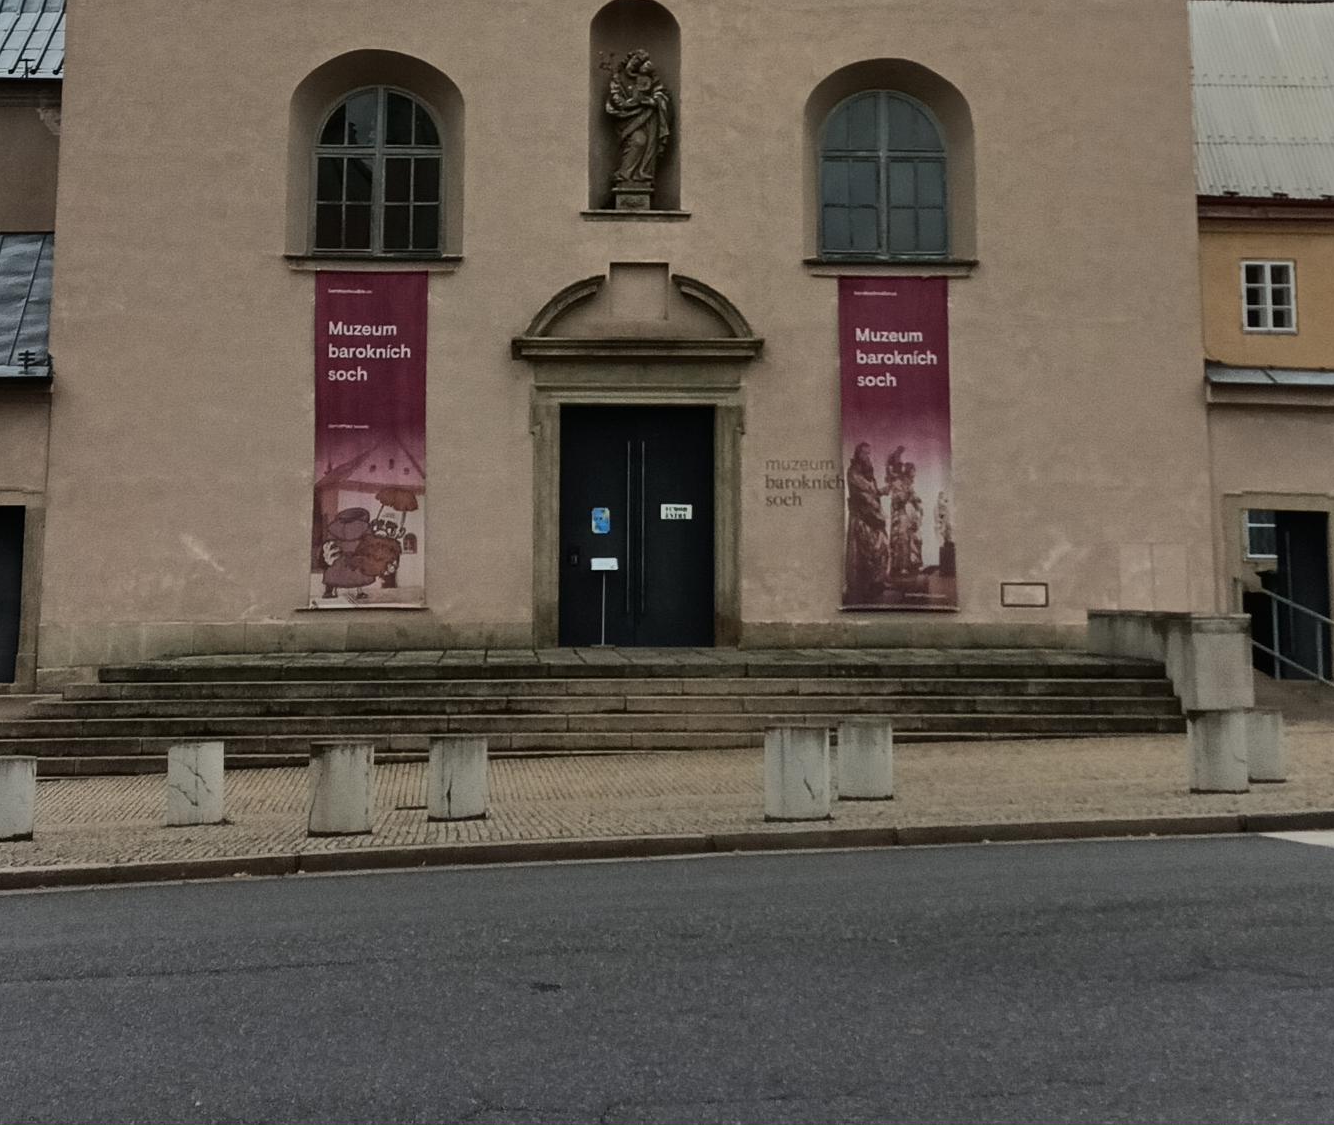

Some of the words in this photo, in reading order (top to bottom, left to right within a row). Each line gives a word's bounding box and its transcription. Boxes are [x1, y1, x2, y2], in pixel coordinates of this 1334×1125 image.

[328, 321, 397, 336] Muzeum
[855, 327, 923, 343] Muzeum
[328, 343, 411, 359] barokních
[856, 349, 938, 365] barokních
[327, 365, 368, 382] soch
[856, 372, 897, 387] soch
[765, 459, 835, 472] muzeum
[765, 491, 803, 507] soch
